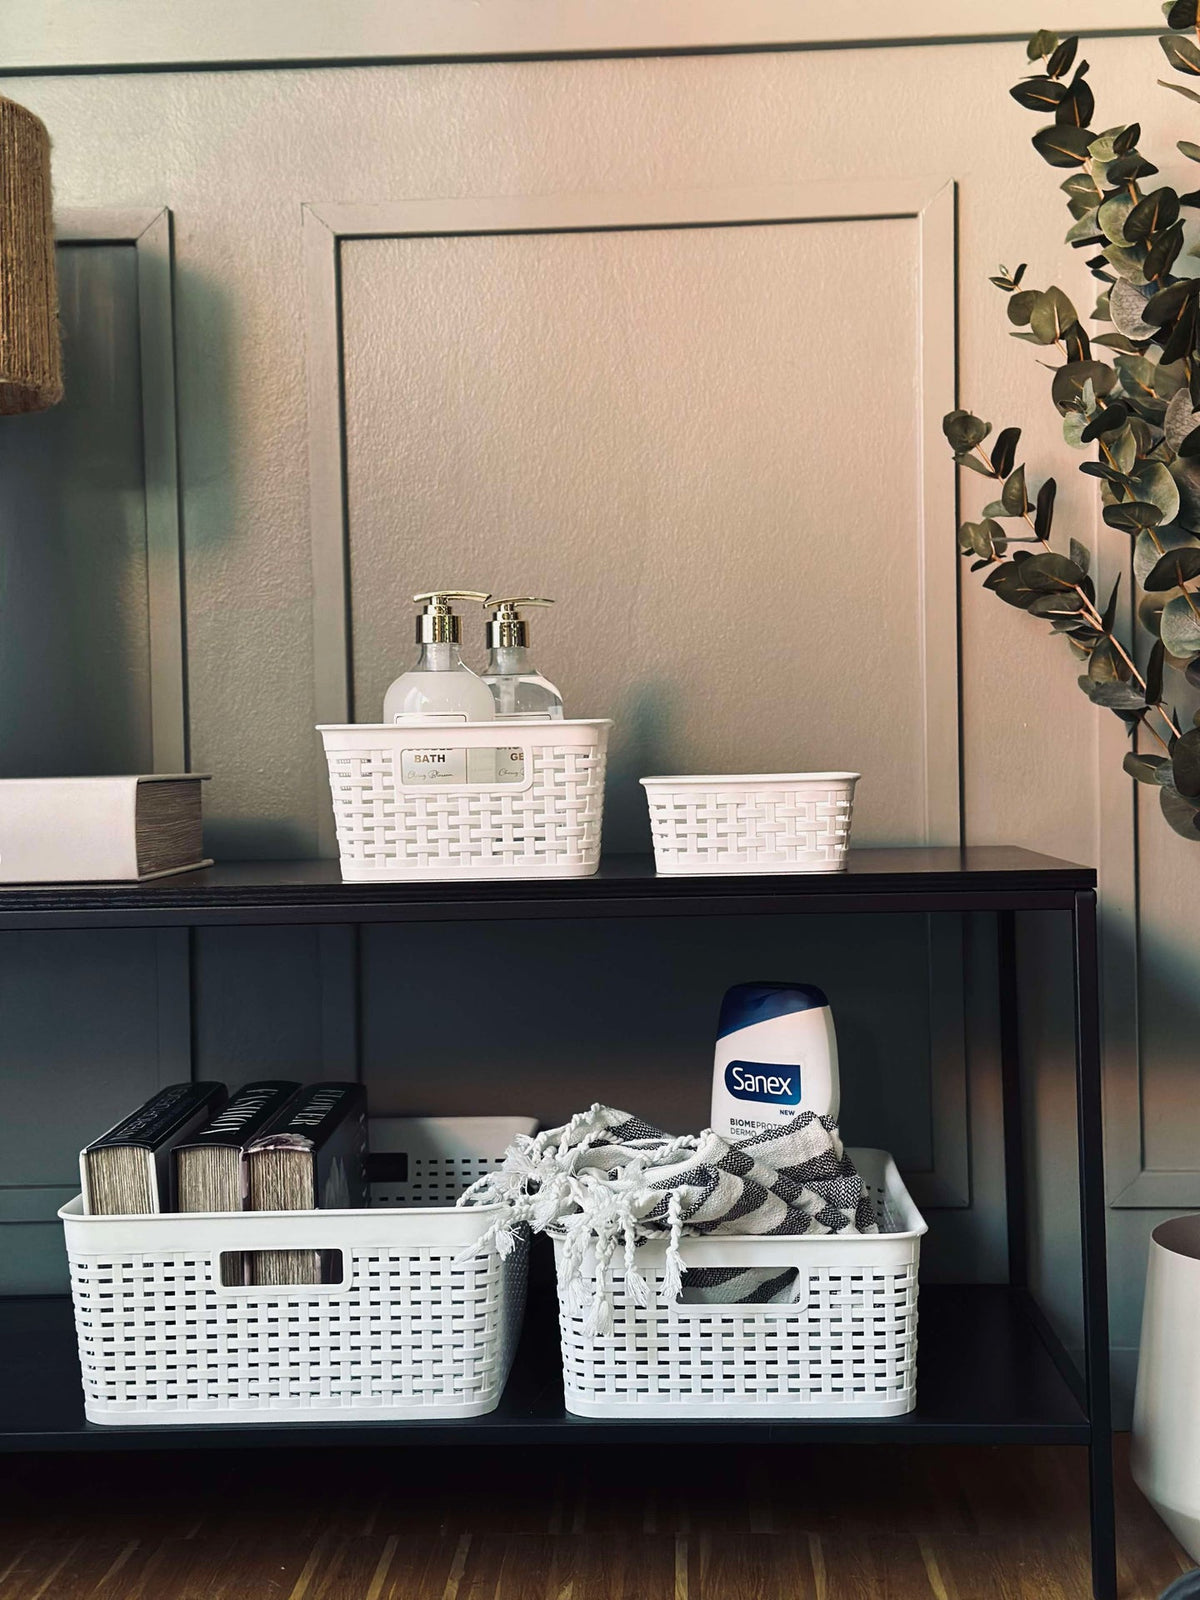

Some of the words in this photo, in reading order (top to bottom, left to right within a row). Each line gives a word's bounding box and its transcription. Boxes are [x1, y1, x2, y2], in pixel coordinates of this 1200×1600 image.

[414, 754, 446, 763] BATH
[732, 1067, 793, 1096] Sanex
[730, 1127, 757, 1137] DERMO
